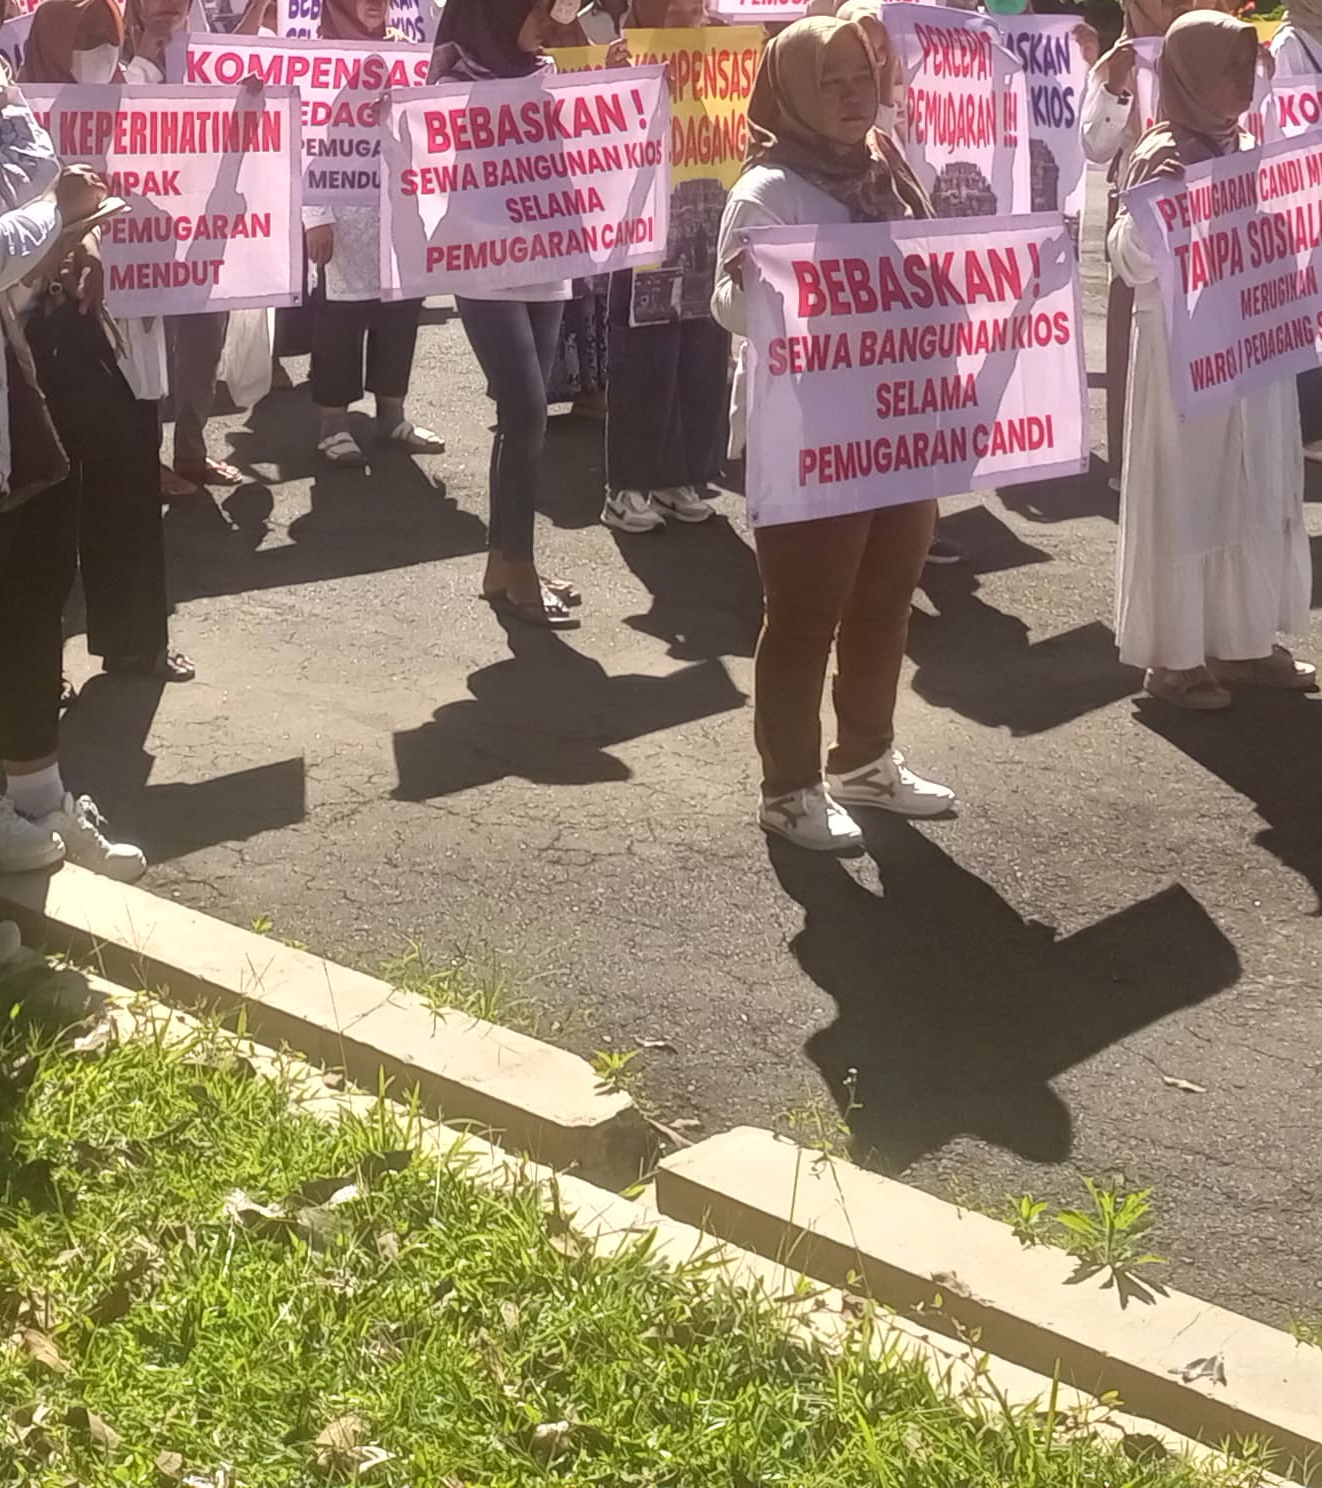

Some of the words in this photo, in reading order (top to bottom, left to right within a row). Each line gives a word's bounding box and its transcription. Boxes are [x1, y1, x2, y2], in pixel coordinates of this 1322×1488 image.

[187, 50, 430, 91] KOMPENSAS
[914, 22, 993, 80] PERCEPAT
[59, 111, 282, 155] KEPERIHATINAN
[424, 94, 628, 154] BEBASKAN
[1030, 85, 1075, 129] KIOS
[300, 138, 381, 158] EMUGA
[670, 109, 748, 168] DAGANG
[103, 170, 182, 197] MPAK
[308, 170, 381, 189] MENDU
[400, 163, 479, 196] SEWA
[482, 144, 623, 189] BANGUNAN
[624, 140, 663, 169] KIOS
[505, 187, 606, 223] SELAMA
[1156, 171, 1258, 232] PEMUGARAN
[1259, 160, 1304, 202] CANDI
[100, 213, 272, 244] PEMUGARAN
[427, 226, 598, 273] PEMUGARAN
[601, 216, 654, 249] CANDI
[109, 260, 225, 290] MENDUT
[792, 247, 1023, 318] BEBASKAN
[1174, 226, 1244, 295] TANPA
[1240, 265, 1319, 320] MERUGIKAN
[768, 332, 853, 376] SEWA
[858, 318, 1009, 367] BANGUNAN
[1010, 311, 1071, 349] KIOS
[1246, 316, 1314, 368] PEDAGANG
[876, 373, 979, 420] SELAMA
[799, 426, 967, 487] PEMUGARAN
[972, 414, 1055, 457] CANDI
